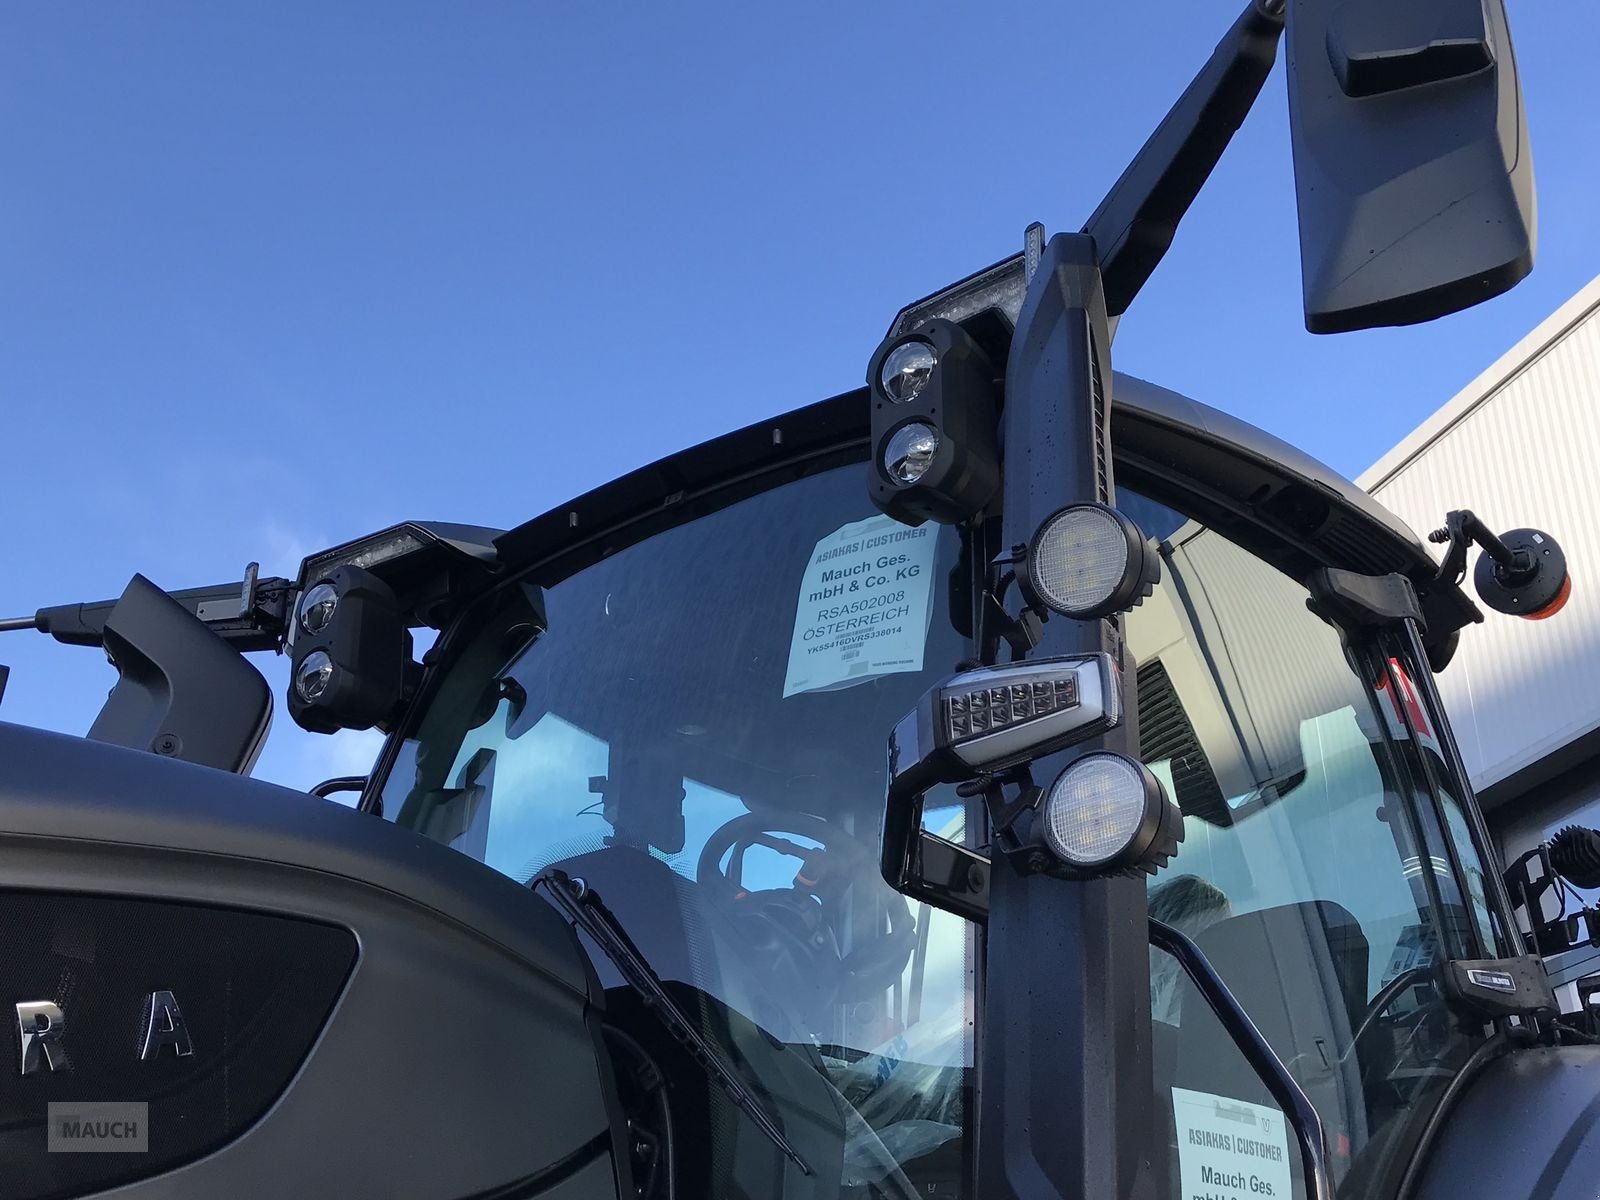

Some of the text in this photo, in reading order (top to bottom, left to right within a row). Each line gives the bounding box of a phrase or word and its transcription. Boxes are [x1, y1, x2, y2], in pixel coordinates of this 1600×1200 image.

[815, 527, 928, 565] ASIAKAS CUSTOMER
[808, 564, 920, 602] mbH & Co. KG
[821, 554, 911, 583] Mauch Ges.
[803, 604, 910, 641] ÖSTERREICH
[817, 590, 905, 623] RSA502008
[1189, 1128, 1282, 1163] ASIAKAS CUSTOMER
[1201, 1165, 1276, 1197] Mauch Ges.
